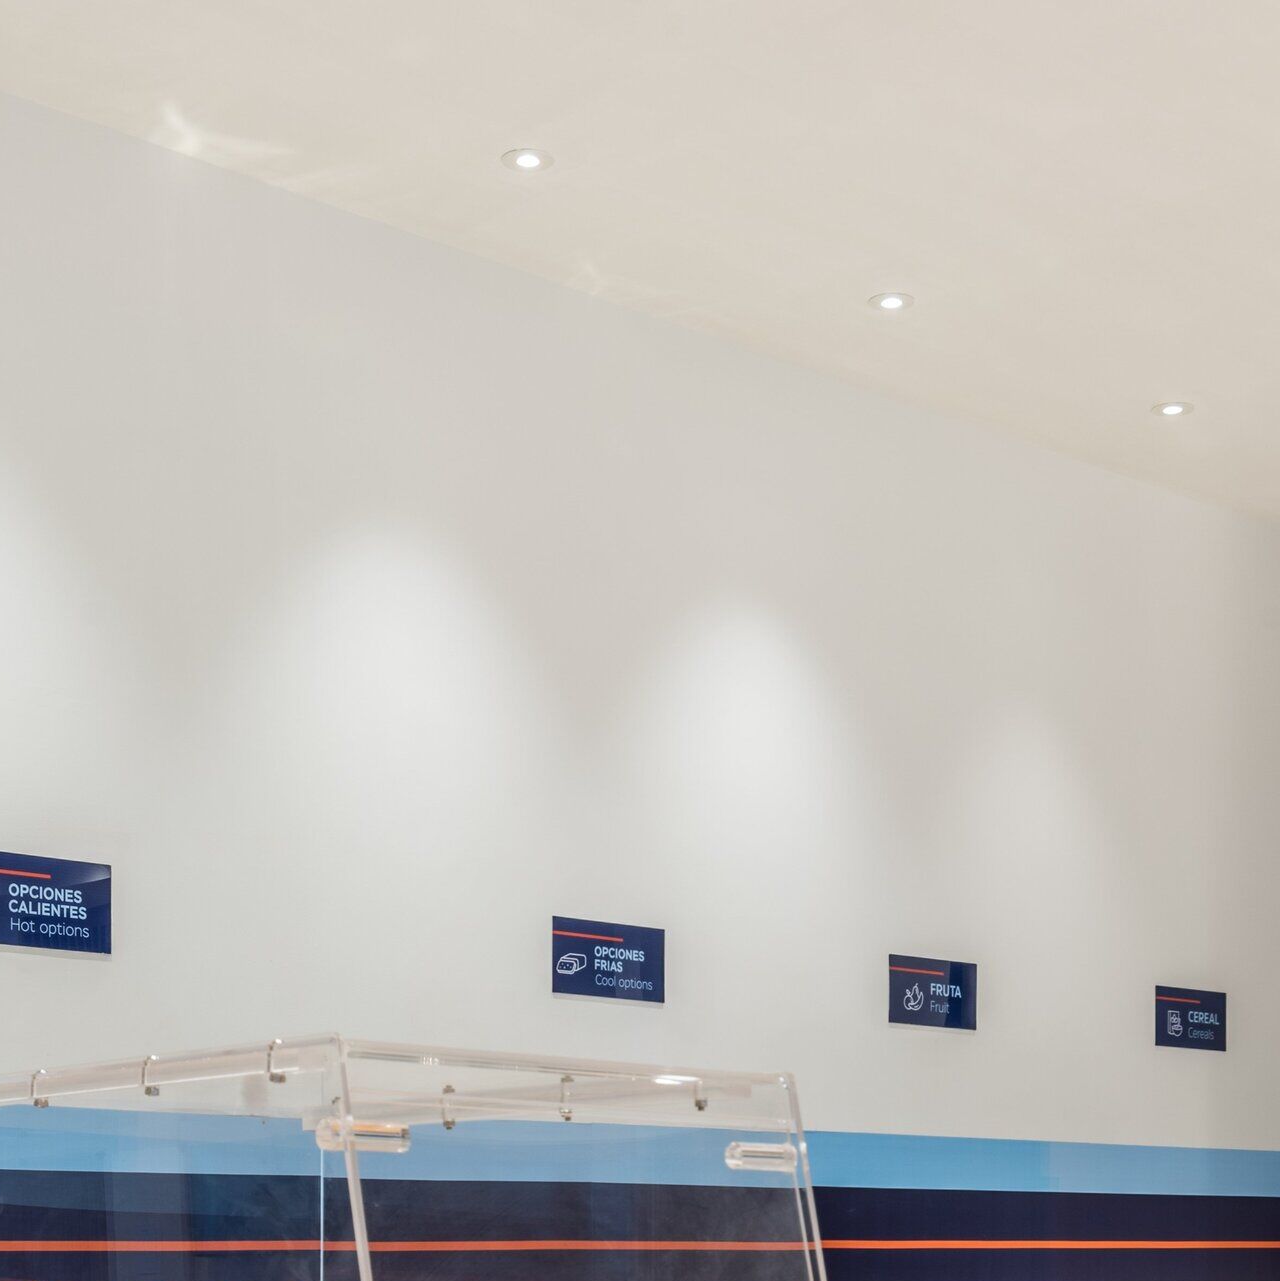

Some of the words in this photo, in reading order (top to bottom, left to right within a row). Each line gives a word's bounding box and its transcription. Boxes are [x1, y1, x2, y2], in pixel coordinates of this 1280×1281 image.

[8, 883, 82, 904] OPCIONES
[8, 899, 87, 920] CALIENTES
[10, 917, 35, 933] Hot
[39, 920, 90, 939] options
[594, 945, 645, 962] OPCIONES
[594, 958, 623, 973] FRIAS
[595, 973, 617, 987] Cool
[618, 977, 653, 991] options
[930, 983, 962, 999] FRUTA
[930, 1000, 950, 1014] Fruit
[1188, 1010, 1220, 1025] CEREAL
[1188, 1026, 1215, 1040] Cereals
